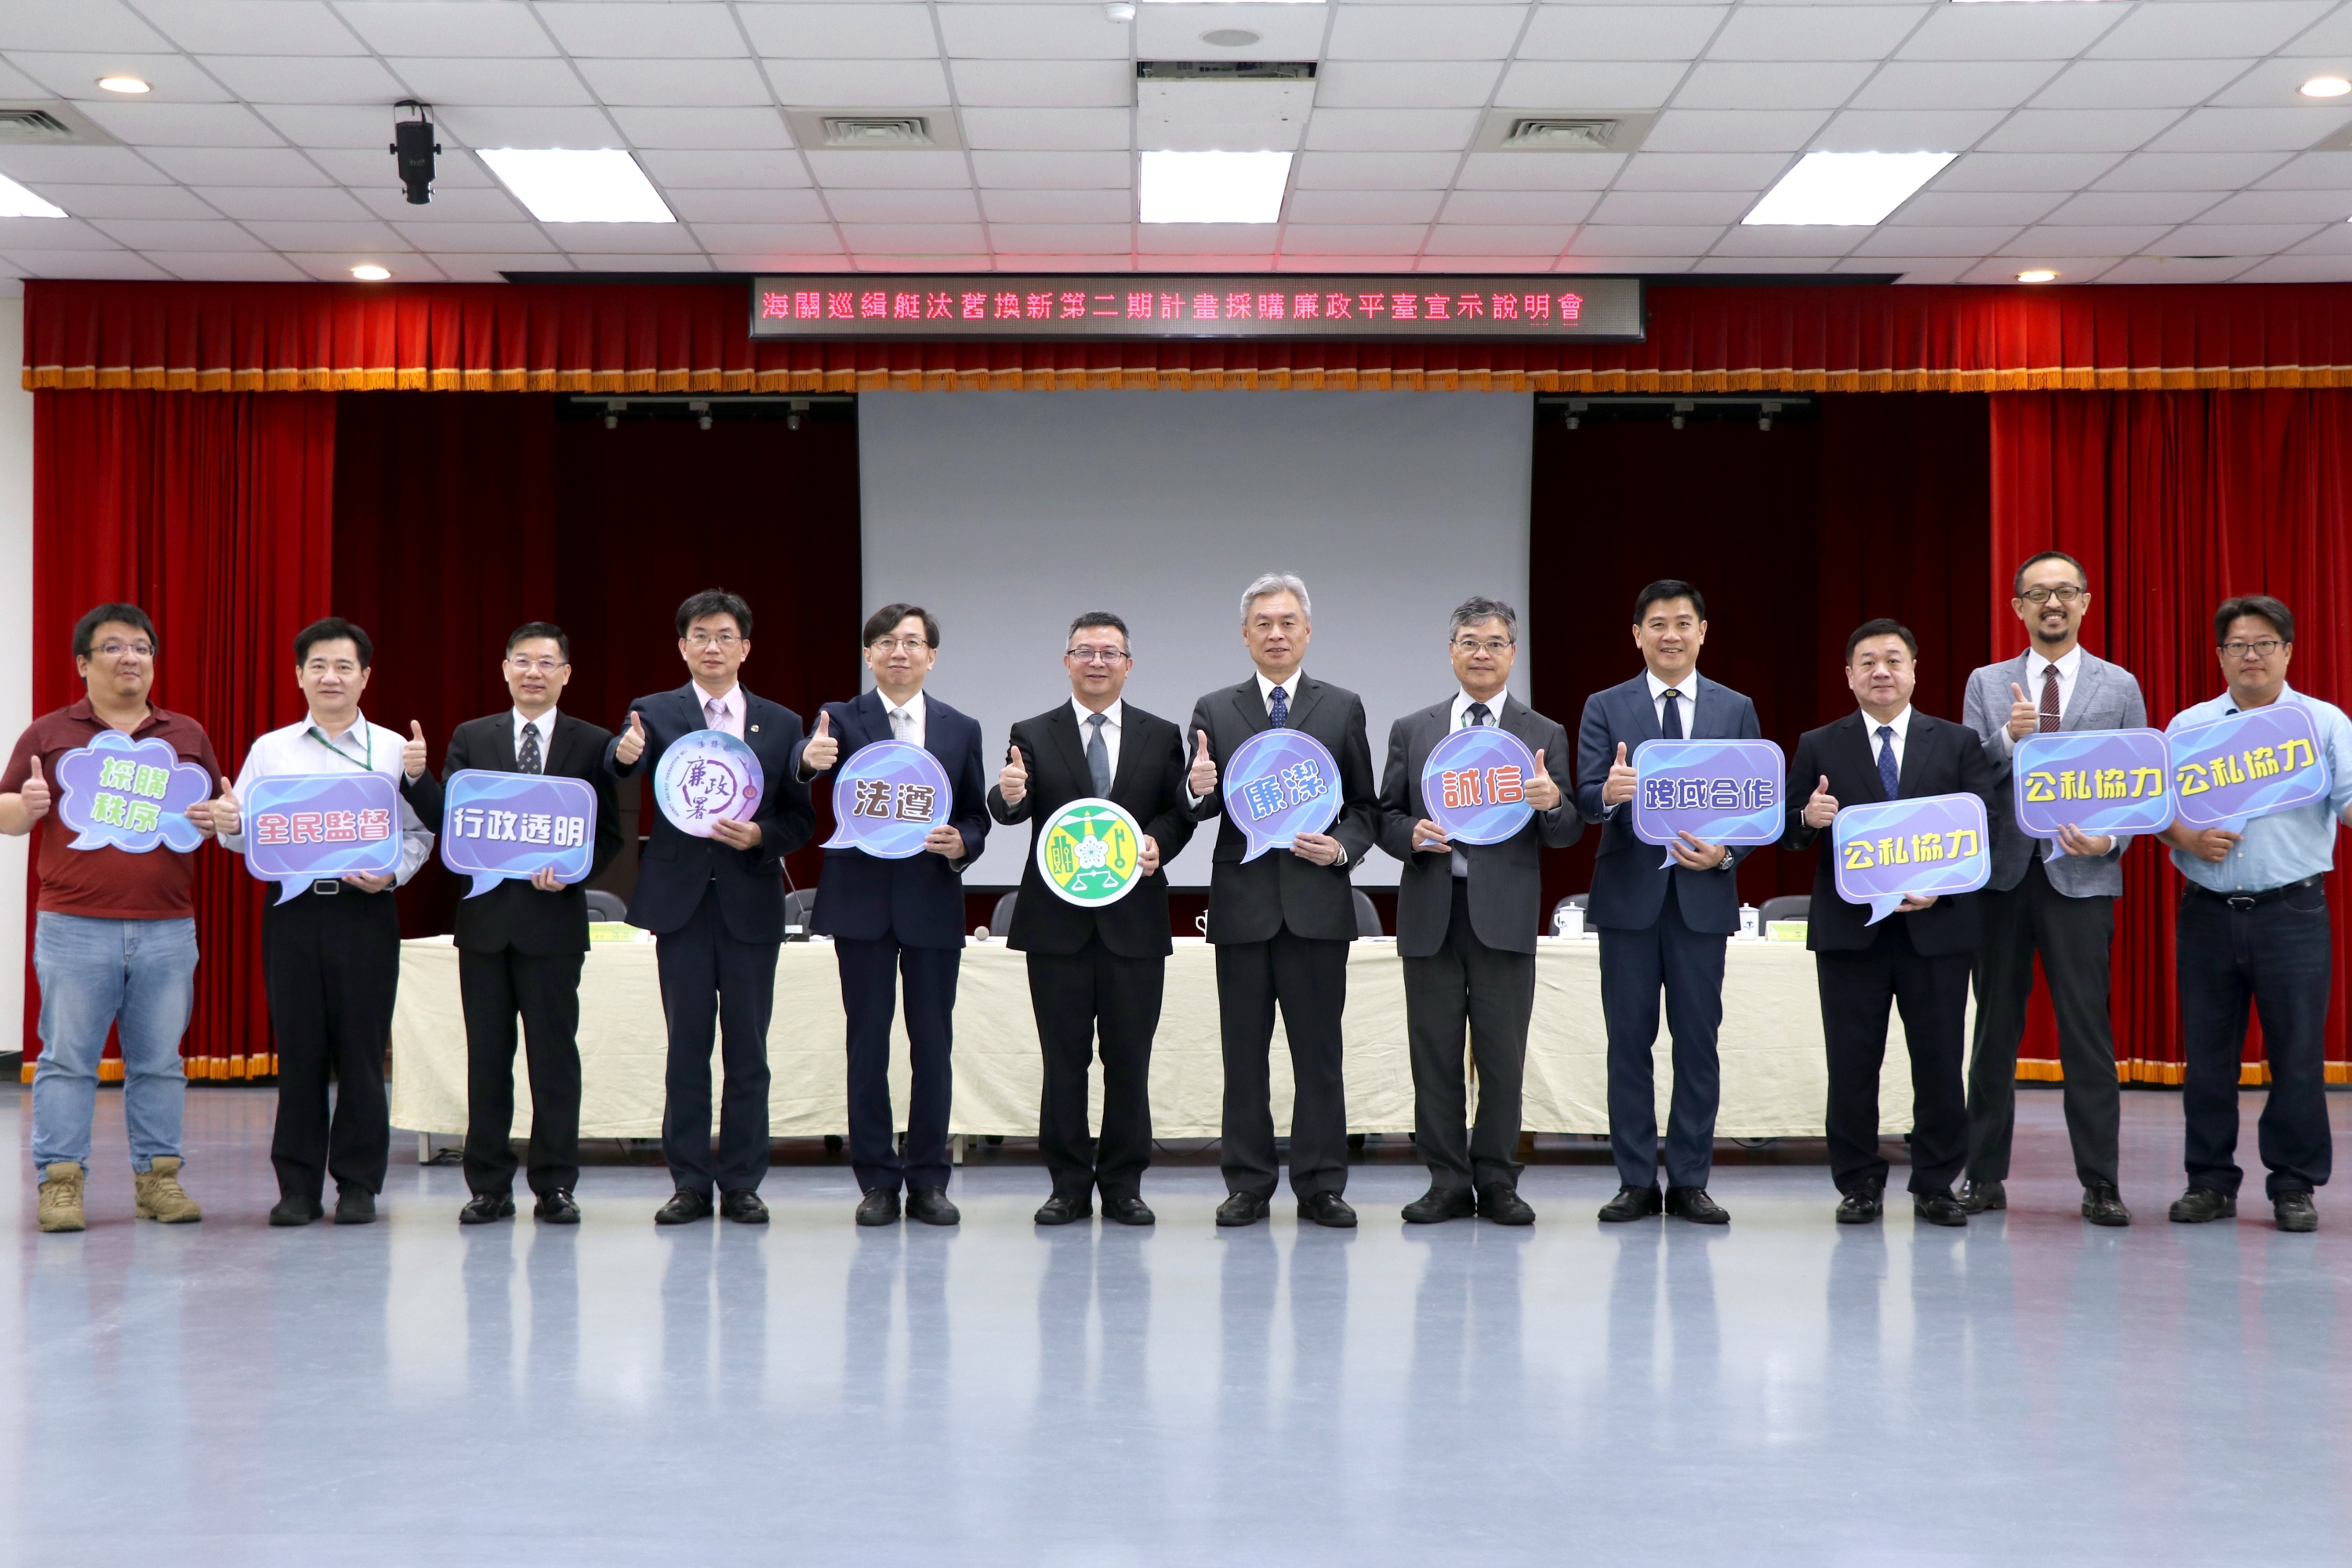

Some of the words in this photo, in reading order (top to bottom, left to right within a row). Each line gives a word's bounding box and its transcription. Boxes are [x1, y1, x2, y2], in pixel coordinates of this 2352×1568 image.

[762, 292, 1584, 320] 海關巡緝艇汰舊換新第二期計畫採購廉政平臺宣示說明會
[698, 740, 731, 753] 法務部
[2176, 737, 2316, 797] 公私協力
[100, 756, 170, 800] 採購
[1243, 758, 1328, 822] 廉潔
[1442, 764, 1524, 809] 誠信
[1644, 777, 1774, 811] 跨域合作
[2024, 767, 2163, 802] 公私協力
[90, 791, 162, 833] 秩序
[852, 779, 937, 823] 法遵
[256, 808, 391, 845] 全民監督
[454, 807, 586, 848] 行政透明
[1843, 829, 1978, 870] 公私協力
